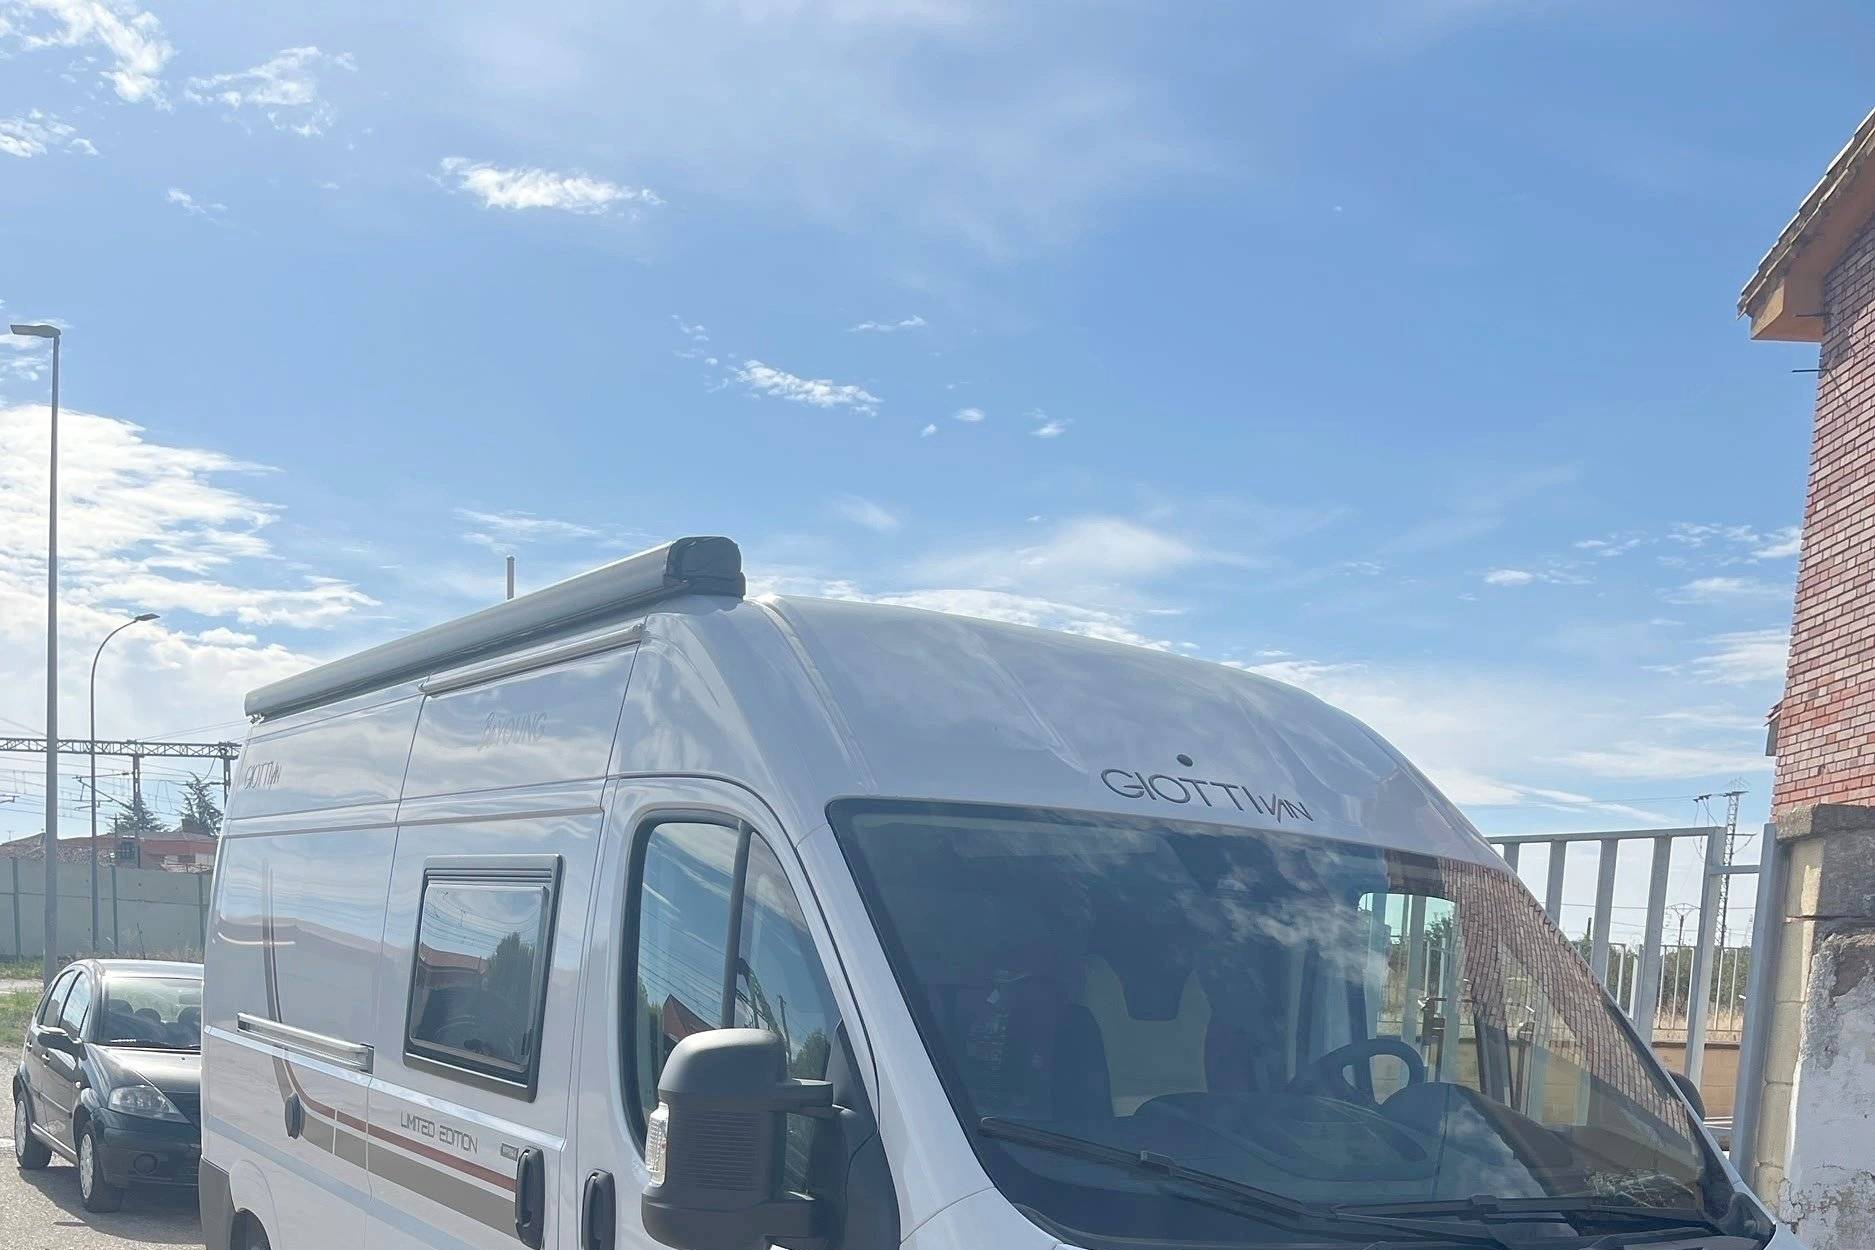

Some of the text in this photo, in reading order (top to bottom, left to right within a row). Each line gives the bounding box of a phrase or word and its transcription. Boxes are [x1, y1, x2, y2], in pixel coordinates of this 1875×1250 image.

[1100, 767, 1314, 823] GIOTTIVAN
[400, 1111, 436, 1138] LIMITED
[439, 1124, 478, 1154] EDITION
